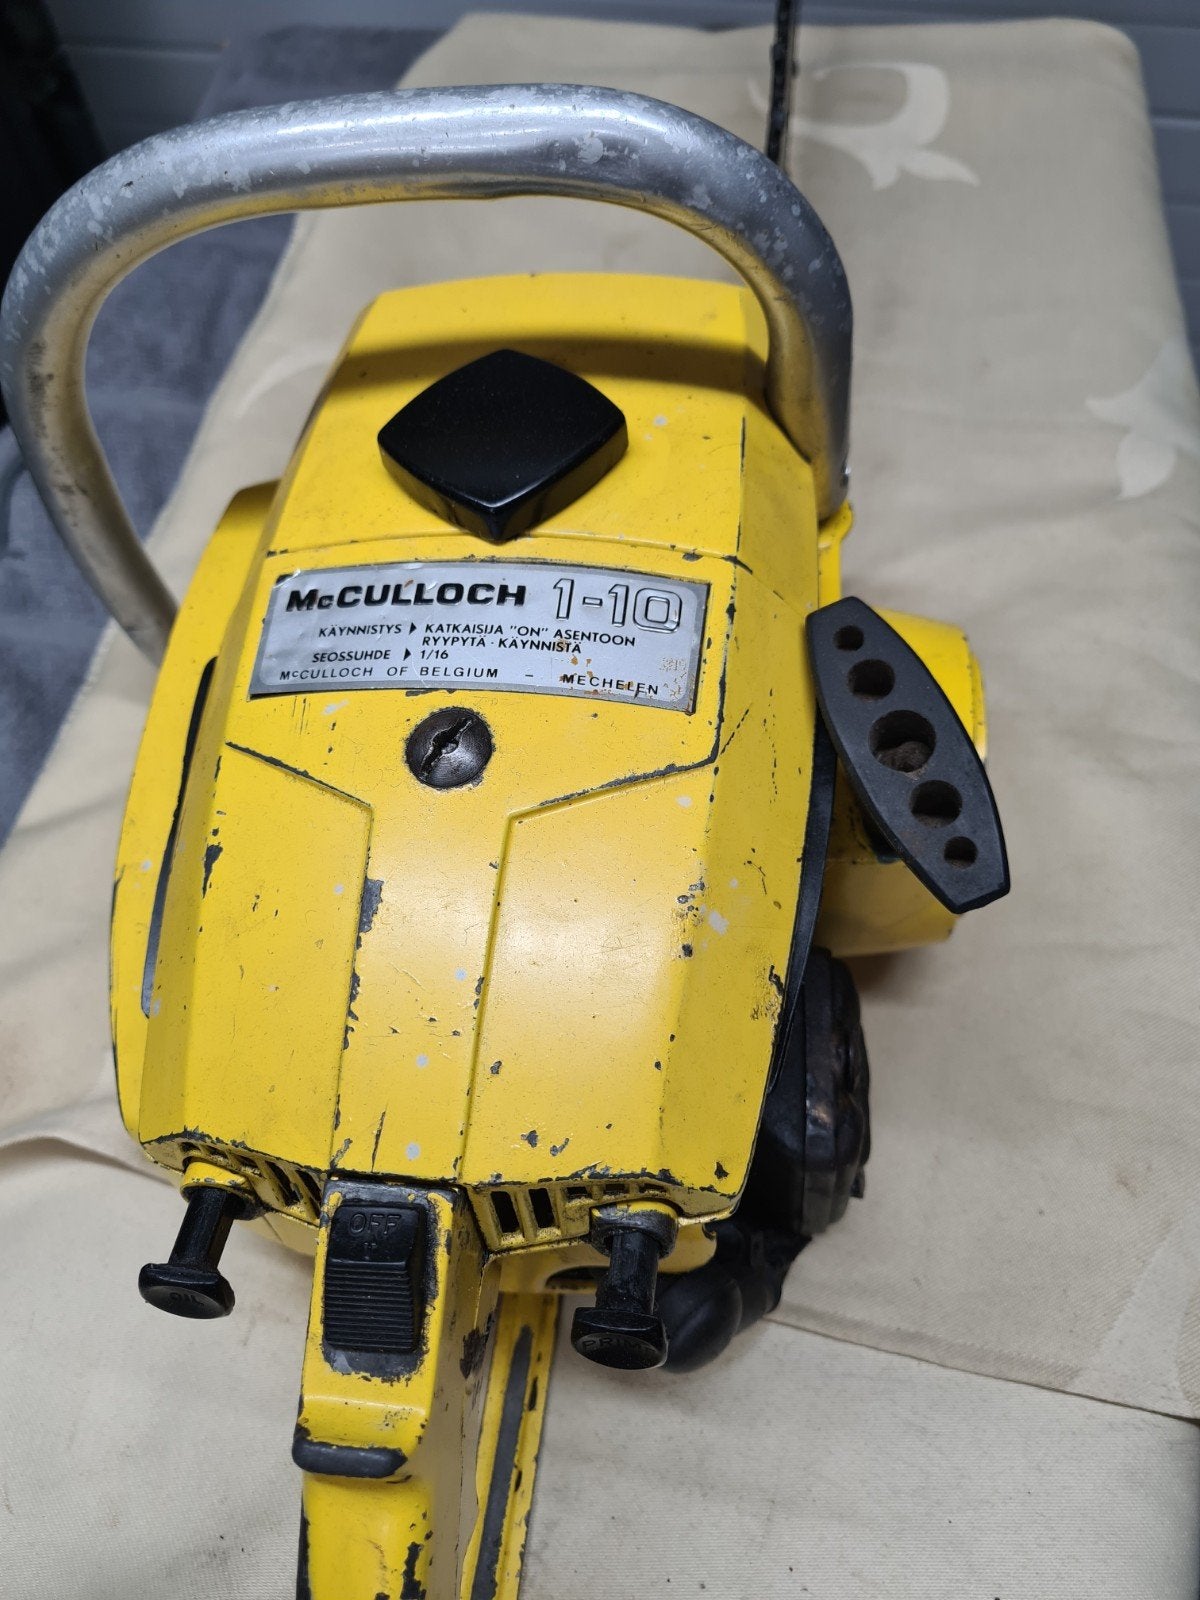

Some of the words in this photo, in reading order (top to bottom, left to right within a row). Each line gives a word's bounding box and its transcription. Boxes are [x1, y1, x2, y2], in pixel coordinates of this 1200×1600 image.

[285, 582, 527, 612] McCULLOCH
[553, 577, 683, 634] 1-10
[318, 623, 402, 637] KÄYNNISTYS
[424, 623, 504, 635] KATKAISIJA
[553, 629, 636, 647] ASENTOON
[422, 635, 486, 647] RYYPYTÄ
[498, 636, 582, 654] KÄYNNISTÄ
[312, 649, 392, 663] SEOSSUHDE
[420, 649, 449, 660] 1/16
[279, 666, 374, 680] McCULLOCH
[386, 666, 409, 677] OF
[419, 666, 499, 678] BELGIUM
[561, 673, 659, 695] MECHELEN
[350, 1212, 401, 1236] OFF
